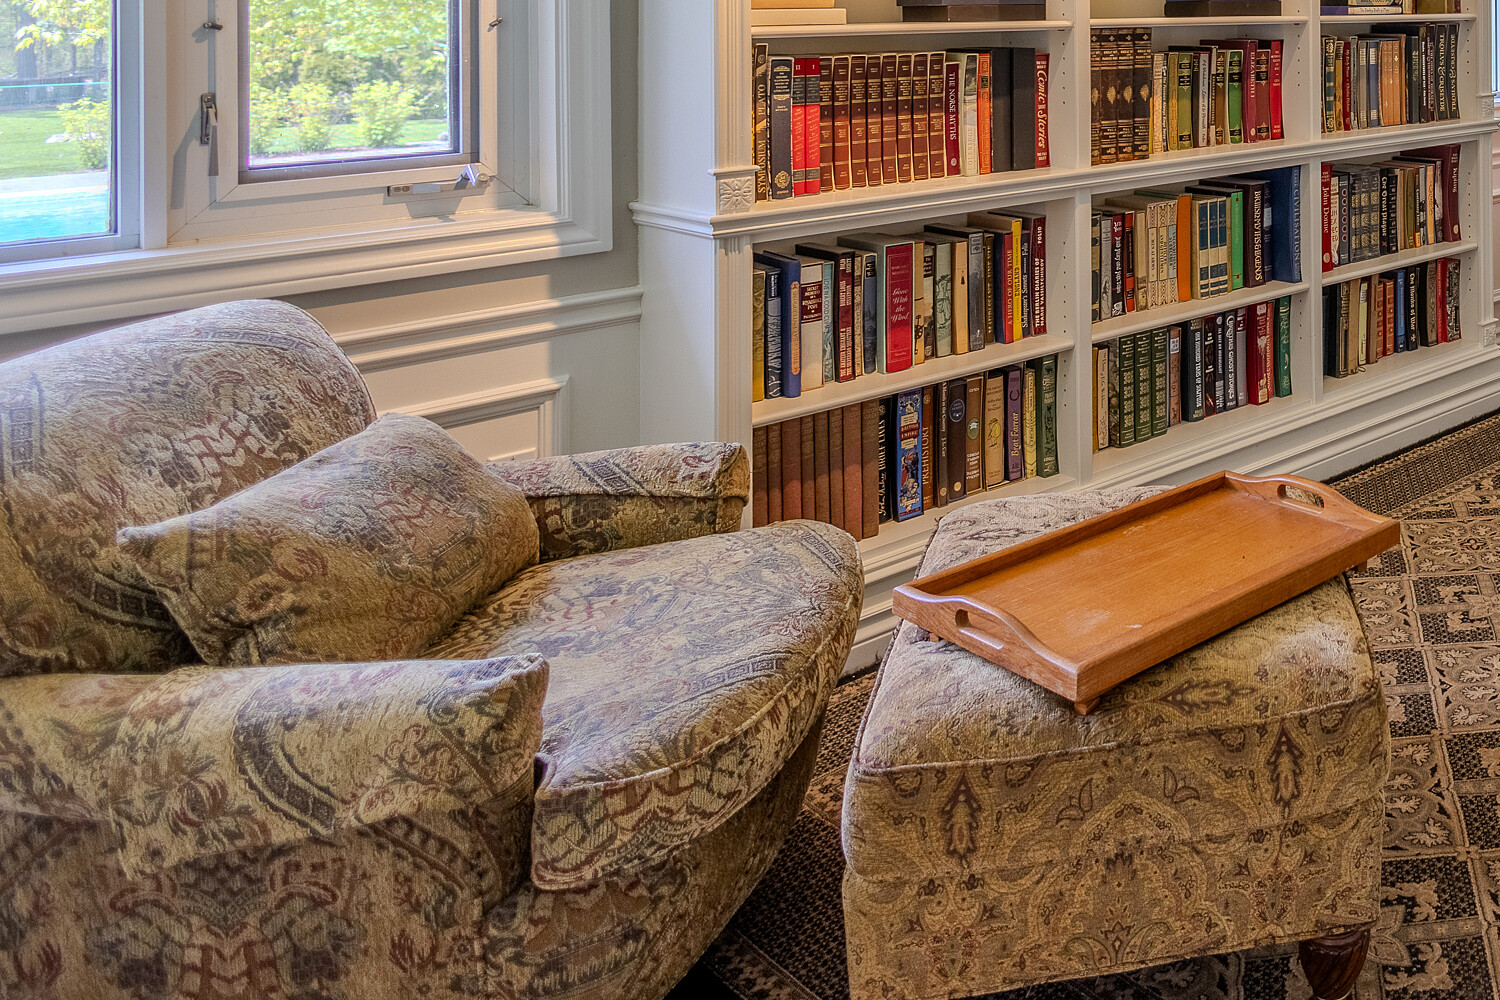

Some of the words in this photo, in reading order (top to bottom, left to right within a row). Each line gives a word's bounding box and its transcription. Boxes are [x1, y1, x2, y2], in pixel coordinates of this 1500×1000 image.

[1037, 70, 1047, 103] Comic
[758, 84, 766, 115] PLATO
[1038, 110, 1046, 148] Stories
[756, 140, 766, 193] SYMPOSIUM
[1254, 219, 1262, 244] MYTHS
[1254, 251, 1262, 280] LEGENDS
[892, 288, 909, 296] Gone
[890, 312, 910, 324] Wind
[895, 305, 905, 313] the
[1022, 296, 1030, 327] Shakespeare's
[878, 420, 886, 442] LIVES
[1011, 413, 1019, 436] Farrar
[1011, 439, 1021, 456] Brat
